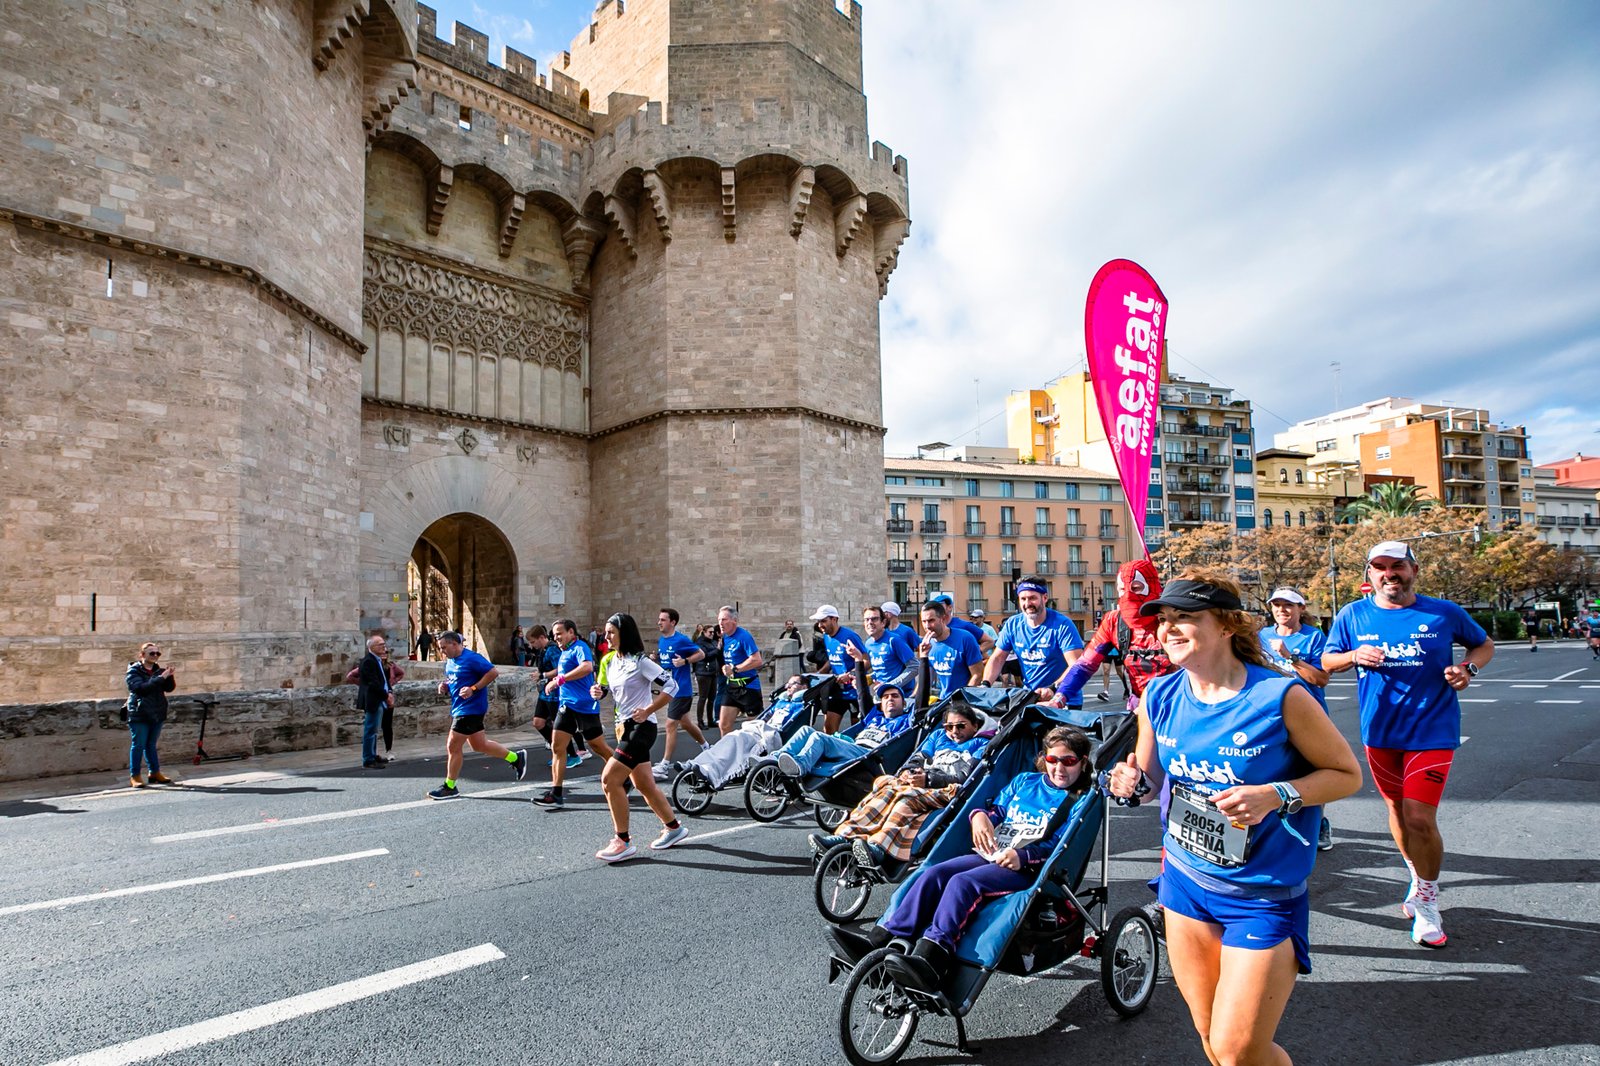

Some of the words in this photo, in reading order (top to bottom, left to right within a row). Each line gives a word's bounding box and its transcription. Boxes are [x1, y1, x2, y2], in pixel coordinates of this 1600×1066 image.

[1115, 291, 1154, 450] aefat
[1139, 301, 1163, 457] www.aefat.es
[1217, 746, 1262, 757] ZURICH
[1183, 809, 1225, 836] 28054
[1180, 824, 1225, 855] ELENA
